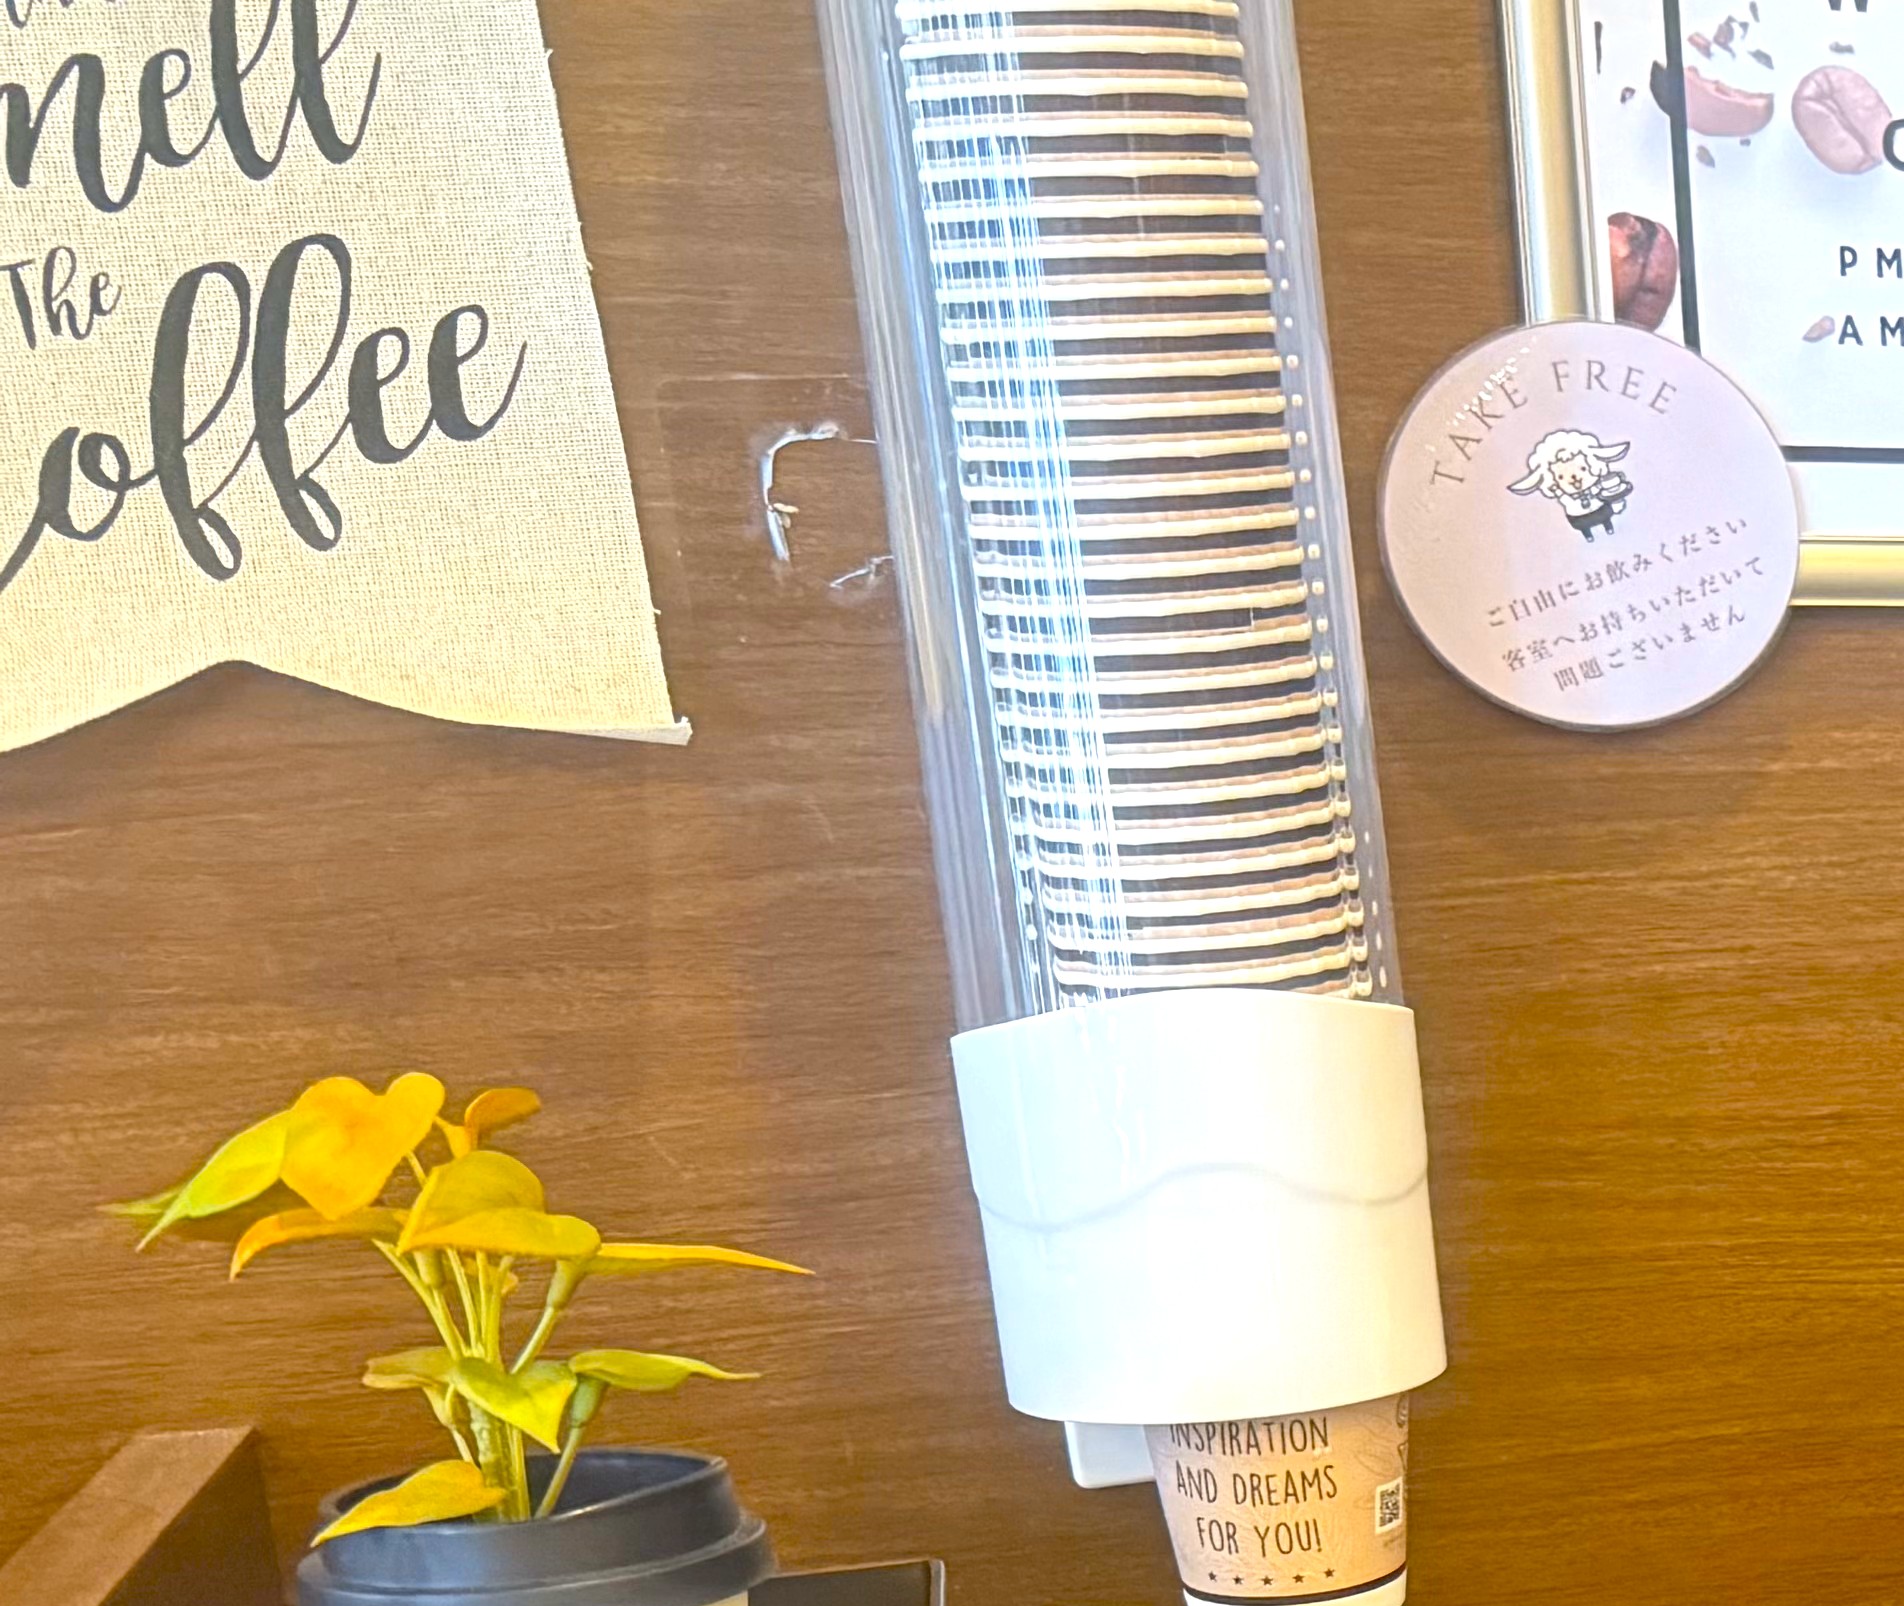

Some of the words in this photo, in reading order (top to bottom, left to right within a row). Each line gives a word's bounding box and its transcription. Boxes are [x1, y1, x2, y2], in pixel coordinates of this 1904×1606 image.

[0, 246, 122, 350] The
[0, 234, 526, 590] offee
[1430, 374, 1529, 487] TAKE
[1551, 359, 1677, 415] FREE
[1487, 517, 1748, 628] ご自由にお飲みください
[1501, 556, 1765, 673] 客室へお持ちいただいて
[1553, 604, 1746, 692] 問題ございません
[1169, 1416, 1329, 1457] INSPIRATION
[1176, 1460, 1218, 1503] AND
[1233, 1465, 1338, 1508] DREAMS
[1196, 1517, 1239, 1555] FOR
[1254, 1519, 1323, 1558] YOU!
